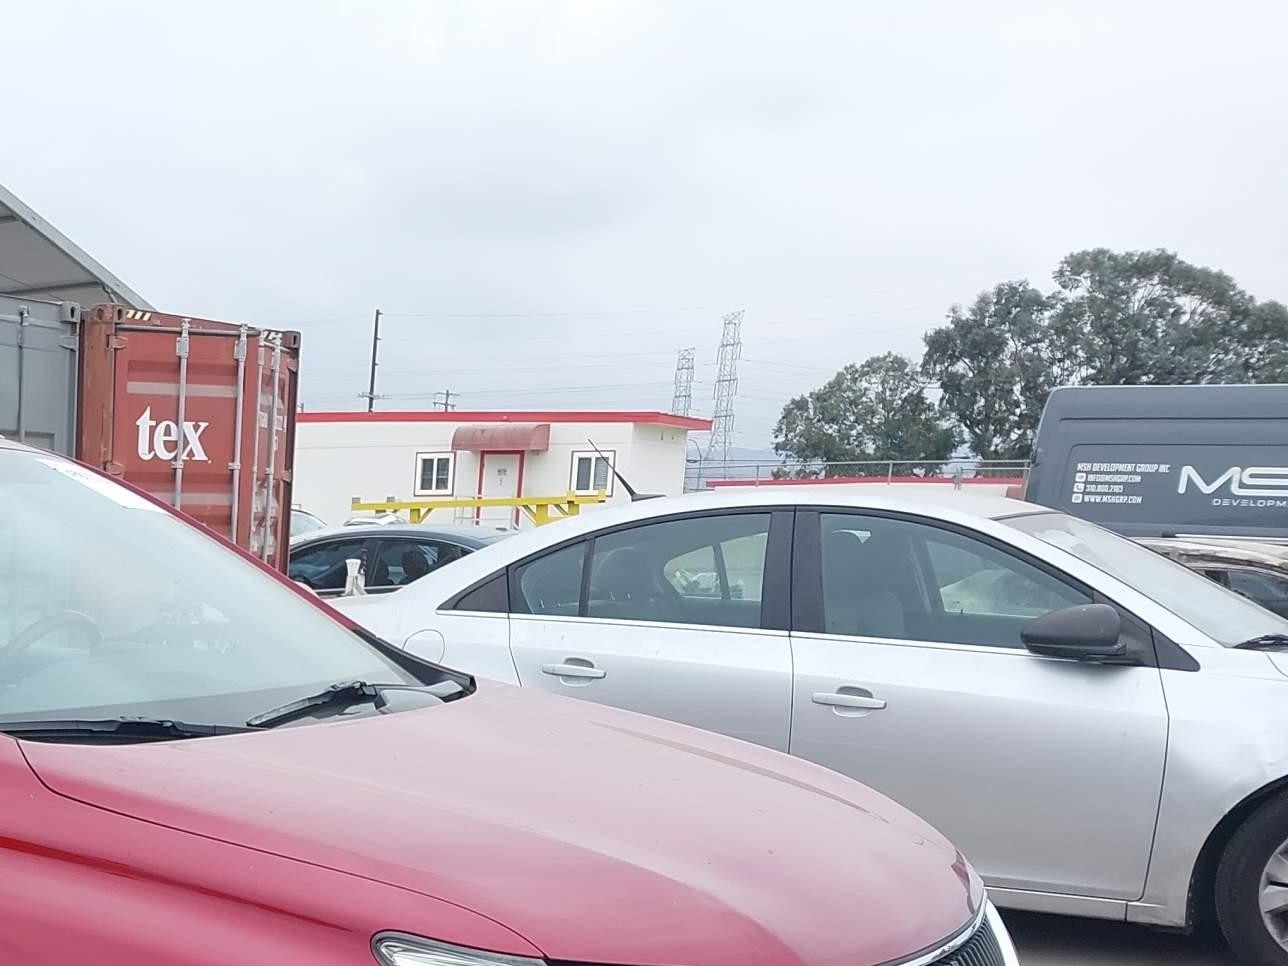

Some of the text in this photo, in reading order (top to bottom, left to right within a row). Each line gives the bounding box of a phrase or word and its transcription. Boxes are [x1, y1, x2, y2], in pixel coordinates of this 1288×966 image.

[1076, 463, 1172, 473] MSH DEVELOPMENT GROUP INC
